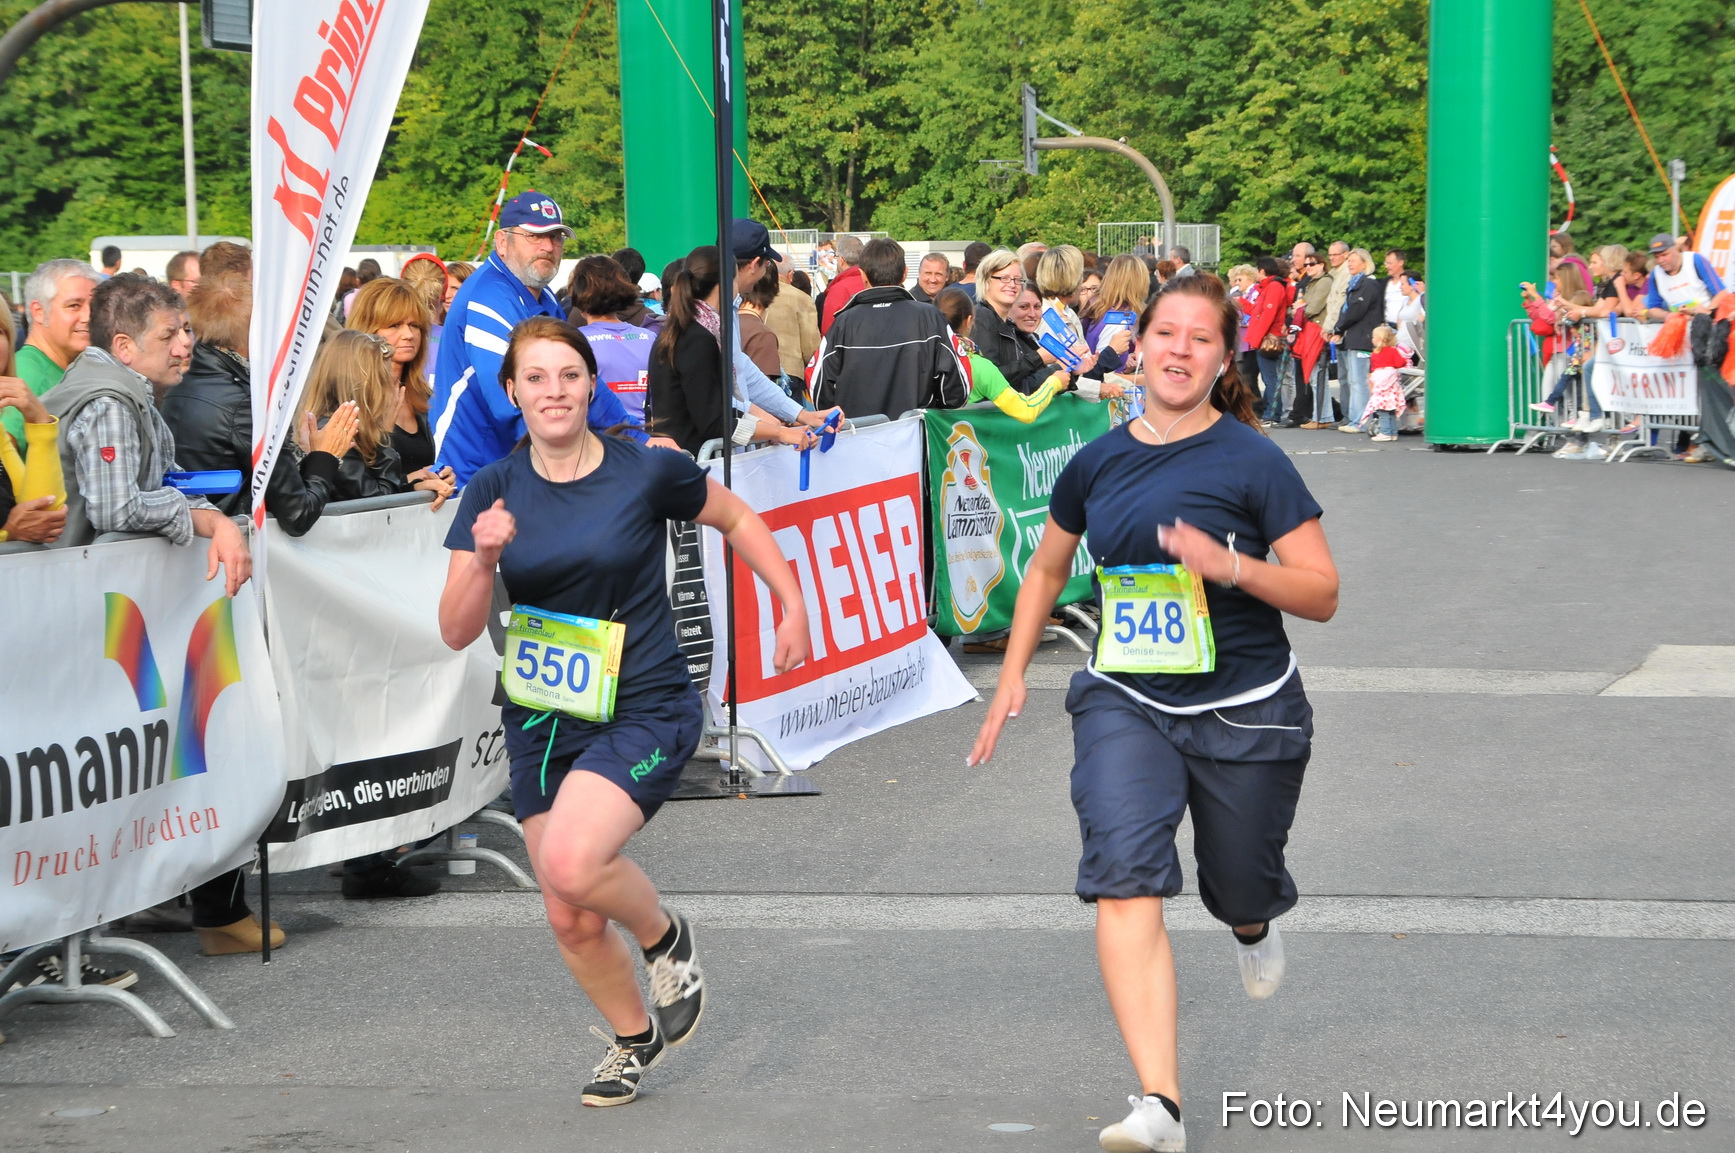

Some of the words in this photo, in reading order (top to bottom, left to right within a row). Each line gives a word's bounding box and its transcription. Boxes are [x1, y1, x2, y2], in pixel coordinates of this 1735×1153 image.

[1114, 601, 1185, 644] 548
[515, 640, 590, 693] 550
[1122, 646, 1154, 656] Denise
[526, 682, 560, 699] Ramona
[0, 719, 169, 828] mann
[354, 779, 383, 804] die
[386, 766, 449, 799] verbinden
[13, 834, 100, 886] Druck
[130, 806, 220, 852] Medien
